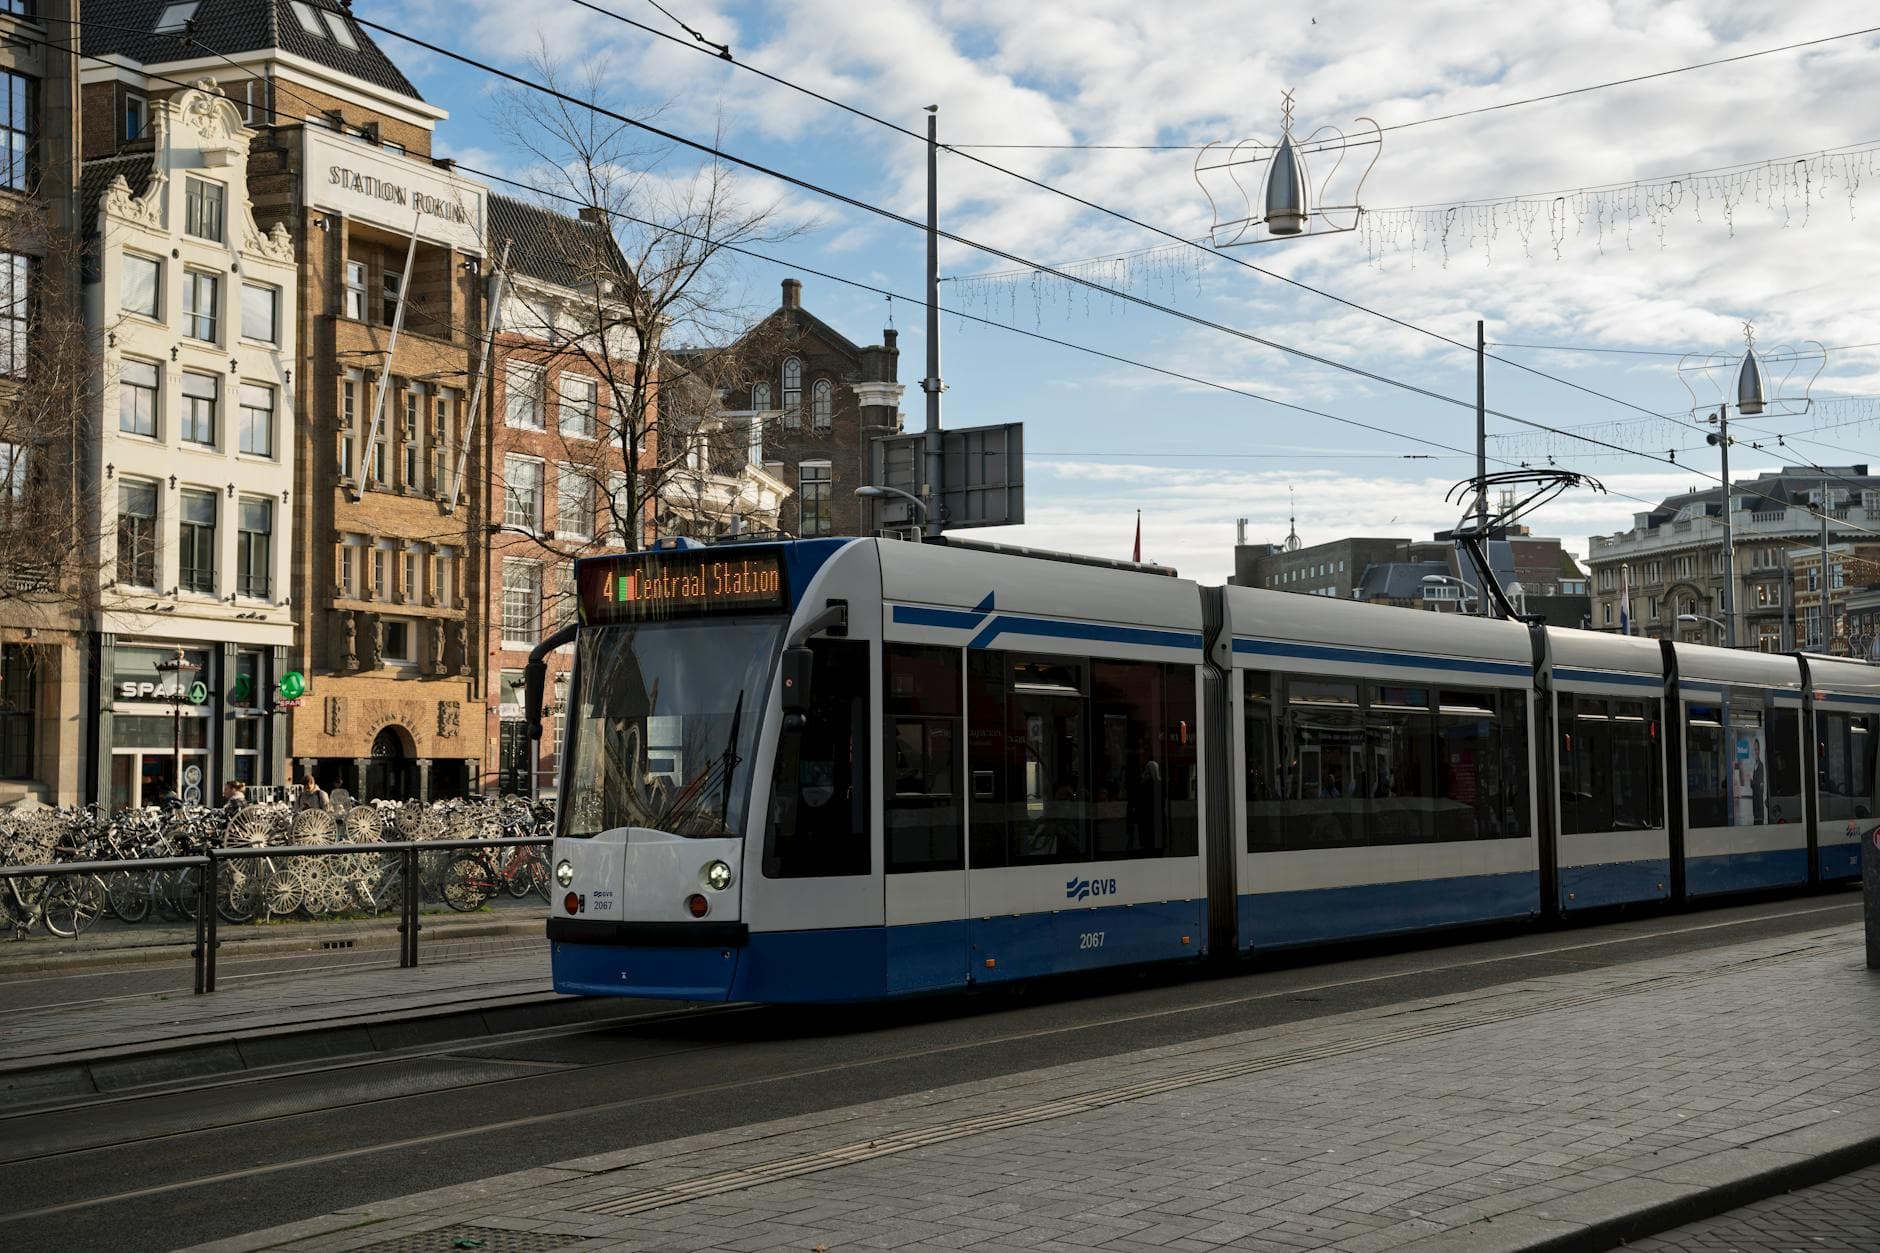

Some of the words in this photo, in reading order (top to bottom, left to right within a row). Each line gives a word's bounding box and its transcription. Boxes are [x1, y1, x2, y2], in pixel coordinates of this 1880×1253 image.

[328, 166, 407, 206] STATION
[412, 191, 467, 224] ROKIN
[603, 571, 613, 602] 4
[634, 563, 706, 601] Centraal
[713, 560, 780, 595] Station
[121, 681, 186, 699] SPAR
[1091, 878, 1117, 896] GVB
[594, 900, 613, 910] 2067
[1080, 932, 1105, 949] 2067
